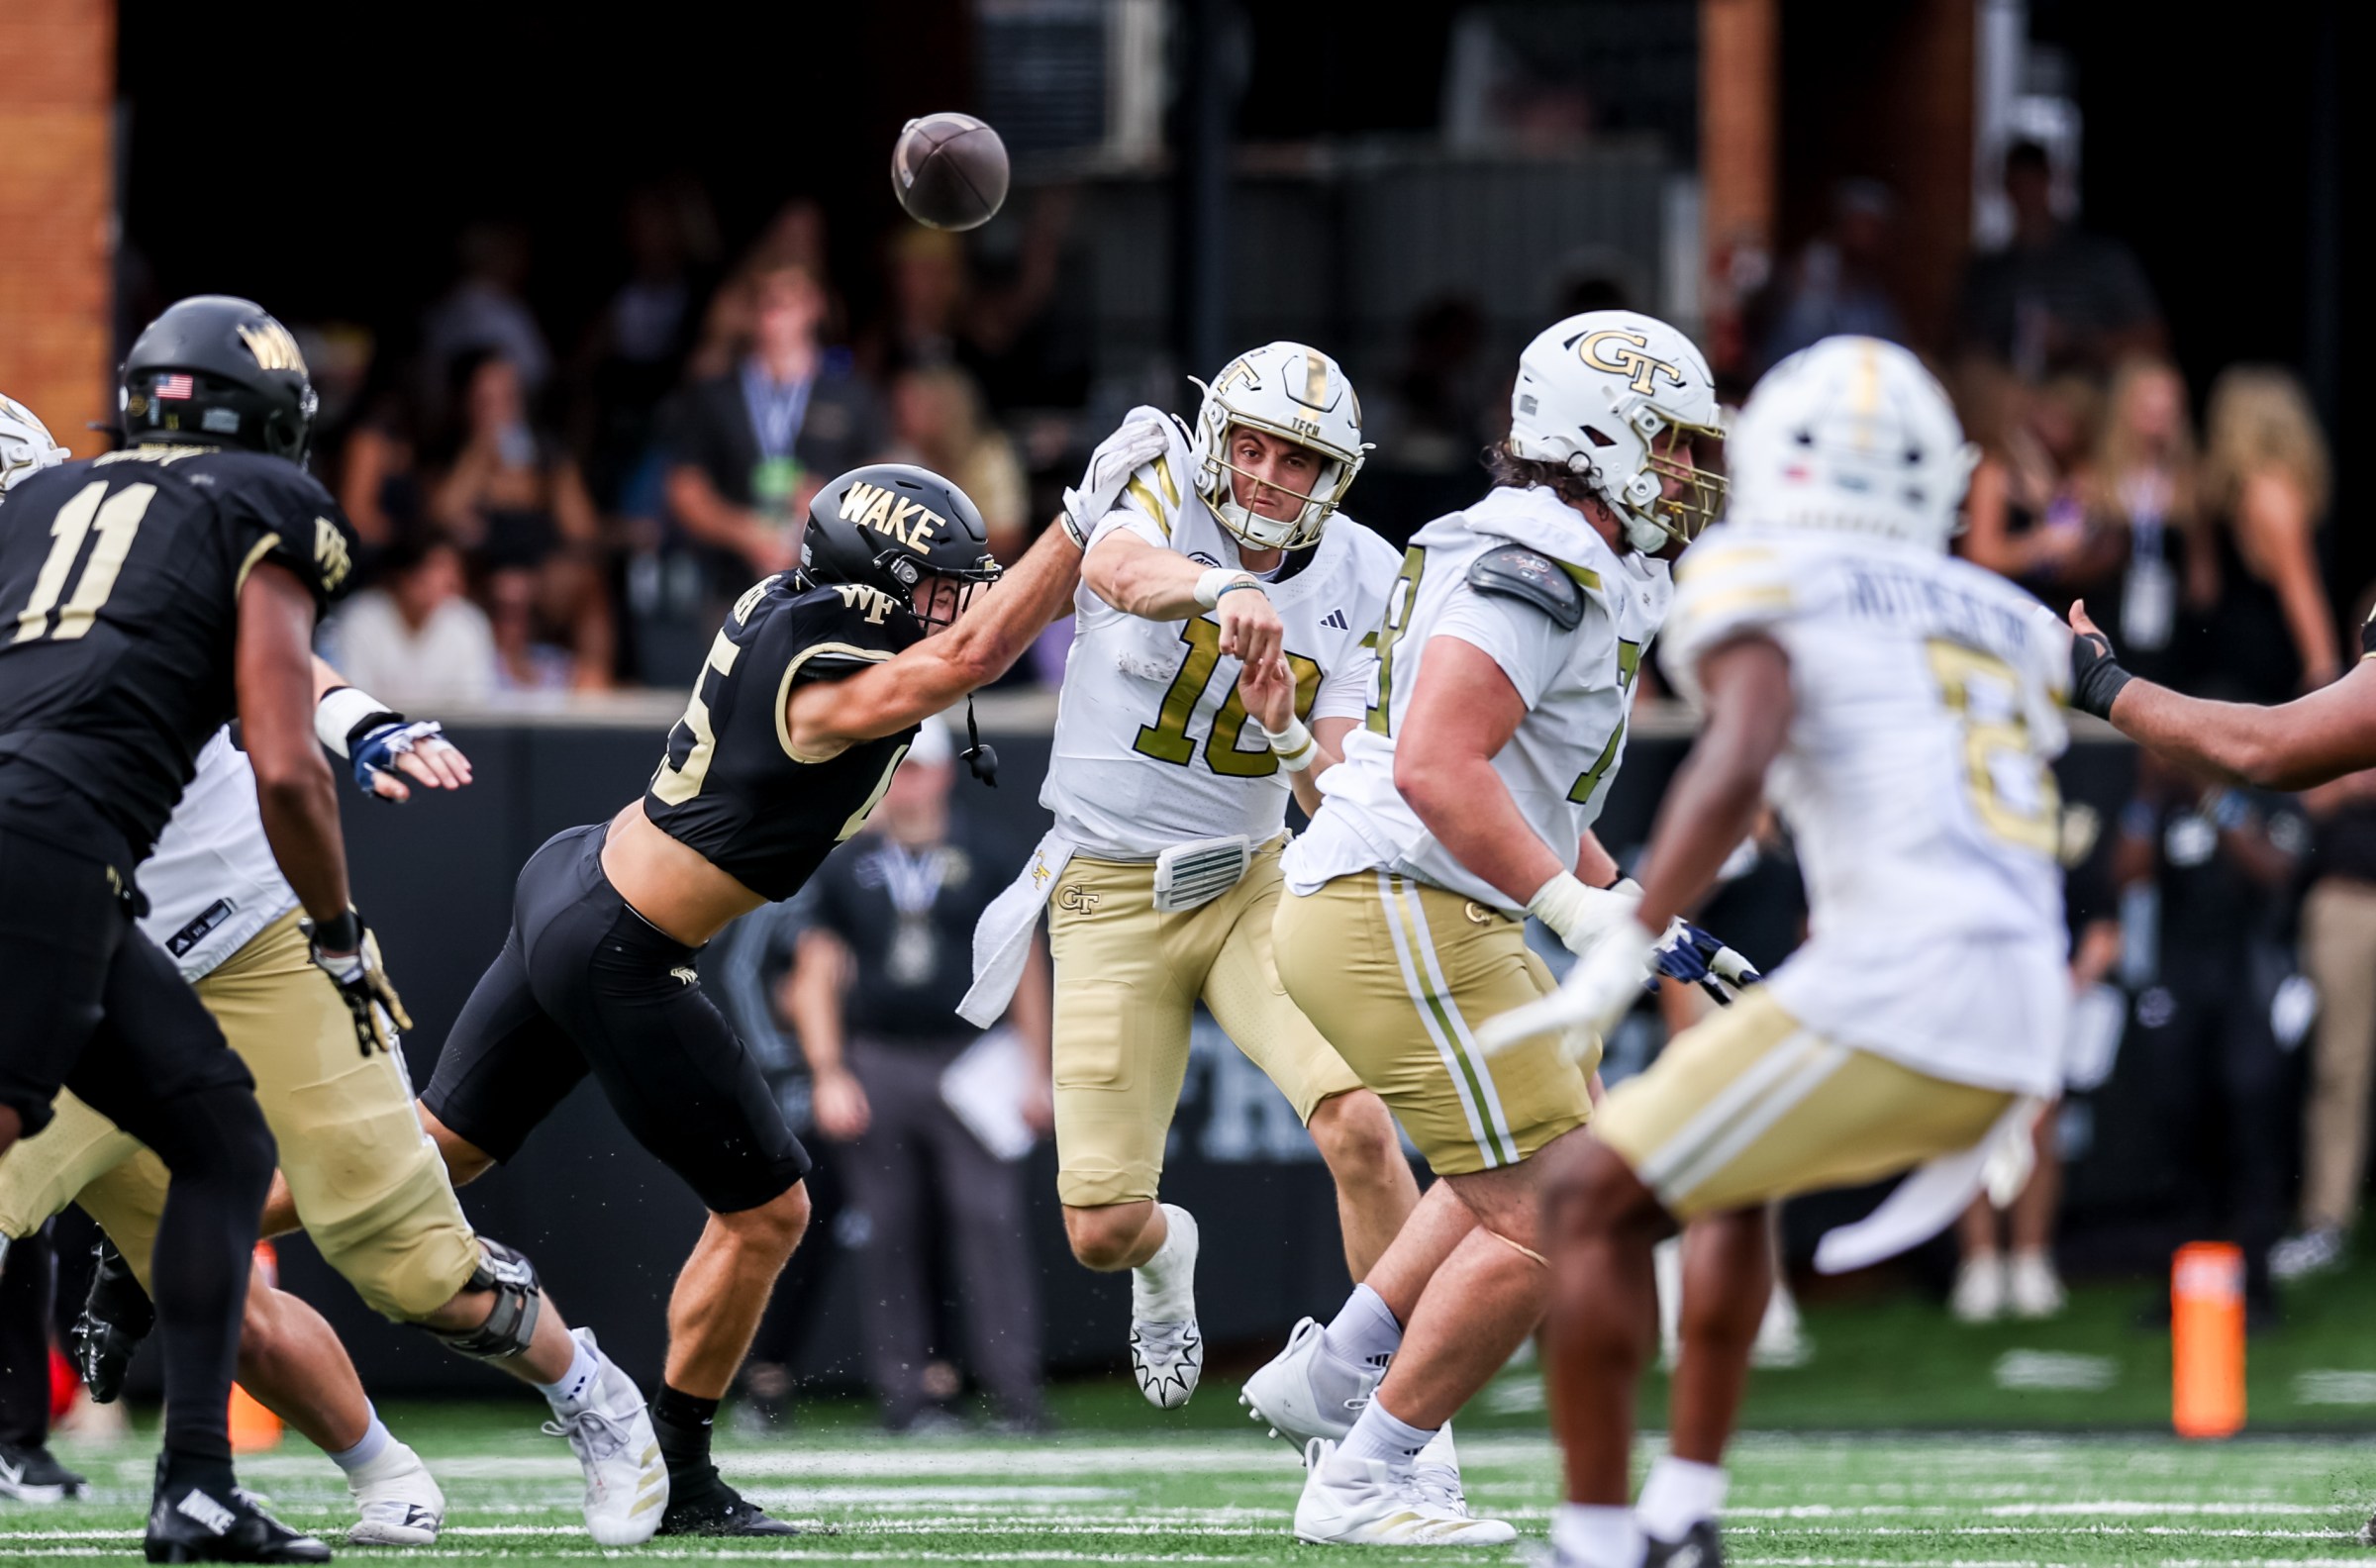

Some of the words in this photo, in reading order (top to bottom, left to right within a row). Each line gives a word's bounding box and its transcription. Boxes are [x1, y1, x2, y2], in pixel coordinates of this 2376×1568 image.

[1578, 330, 1681, 396] GT
[1292, 417, 1321, 438] TECH
[840, 480, 946, 556] WAKE
[9, 480, 157, 644] 11
[832, 583, 902, 626] WF
[648, 627, 742, 807] 5
[1133, 616, 1325, 779] 10
[1926, 637, 2062, 855] 8
[1057, 885, 1100, 916] GT
